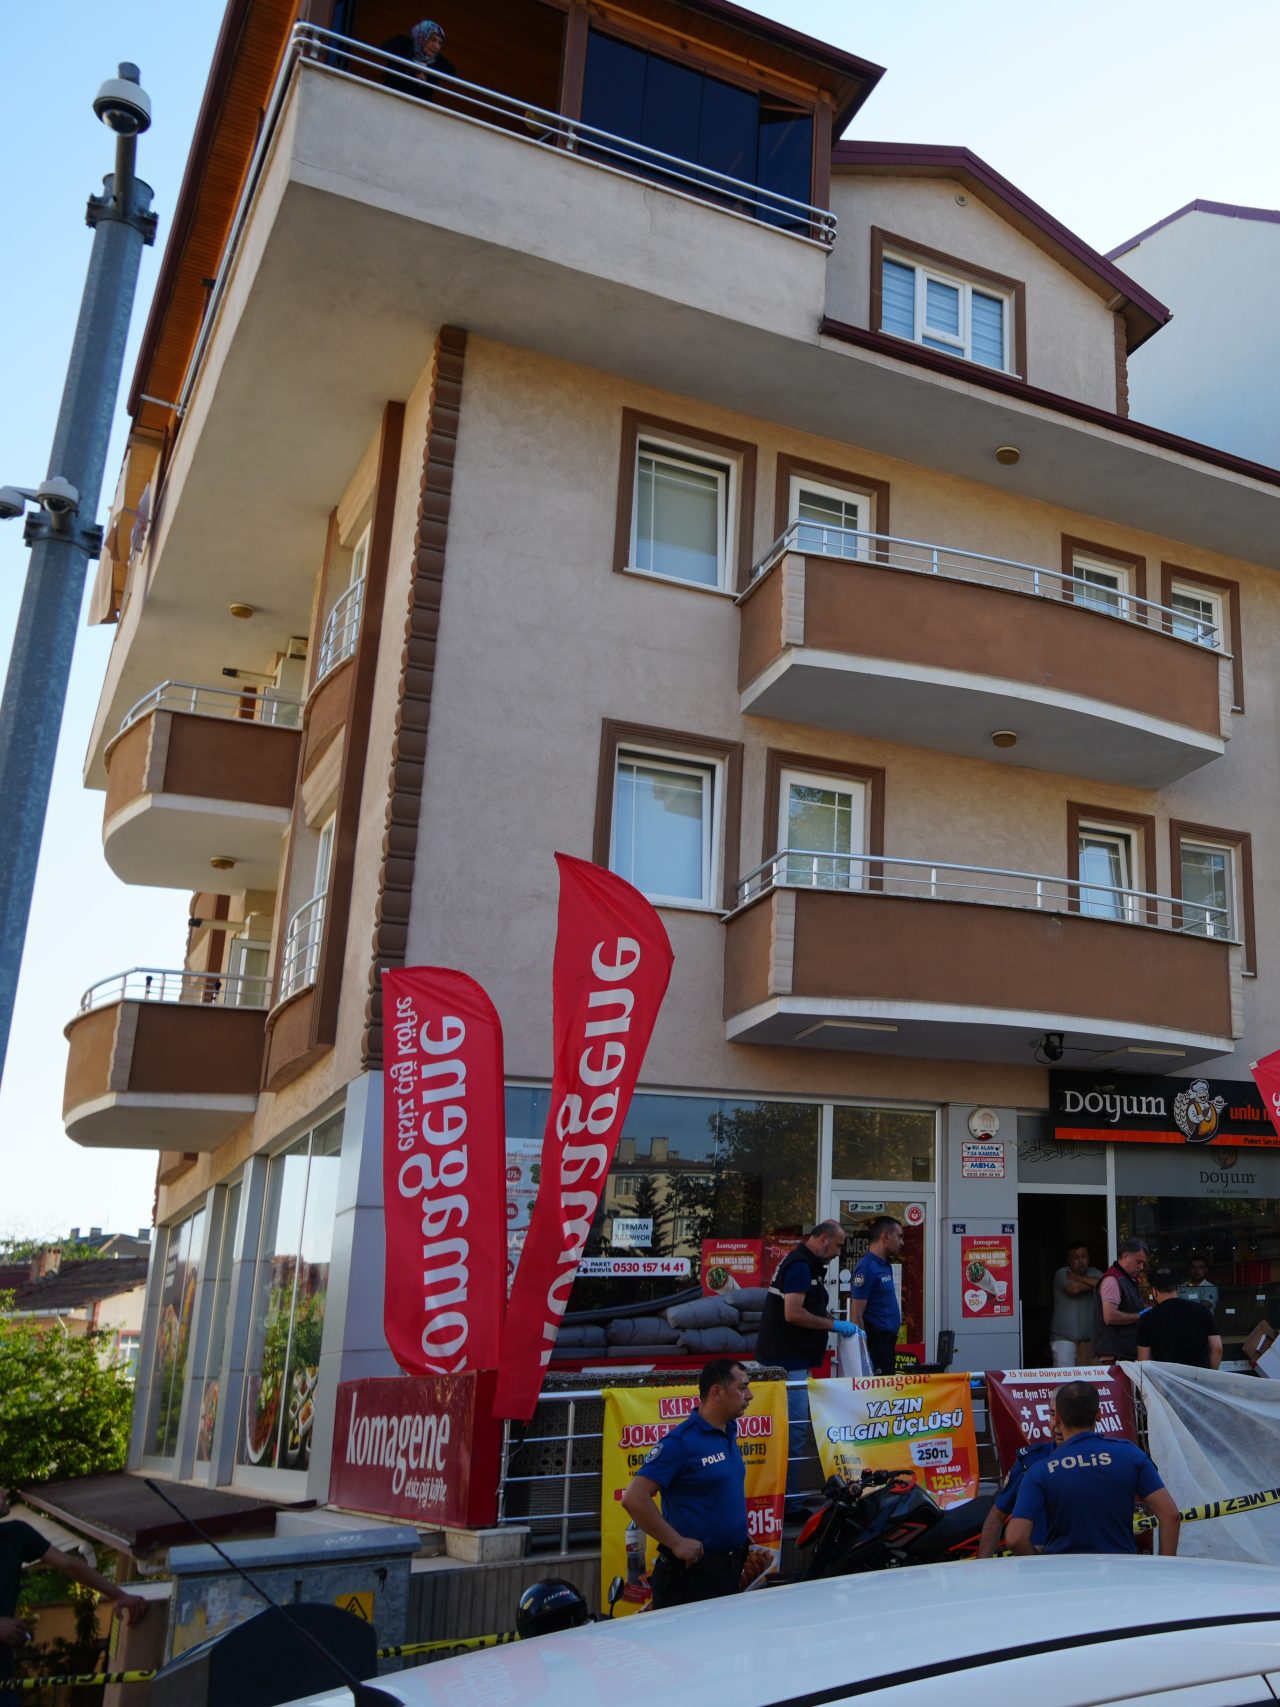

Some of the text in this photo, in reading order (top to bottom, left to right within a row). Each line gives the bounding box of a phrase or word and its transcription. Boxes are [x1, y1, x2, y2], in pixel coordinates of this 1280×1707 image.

[1230, 1104, 1261, 1120] unlu
[613, 1262, 684, 1273] 0530 157 14 41
[1018, 1370, 1037, 1378] Yıldır
[1039, 1369, 1072, 1379] Dünya'da
[852, 1374, 932, 1391] komagene
[866, 1397, 923, 1418] YAZIN
[827, 1408, 964, 1443] ÇILGIN ÜÇLÜSÜ
[346, 1391, 450, 1495] komagene
[834, 1455, 839, 1465] 2
